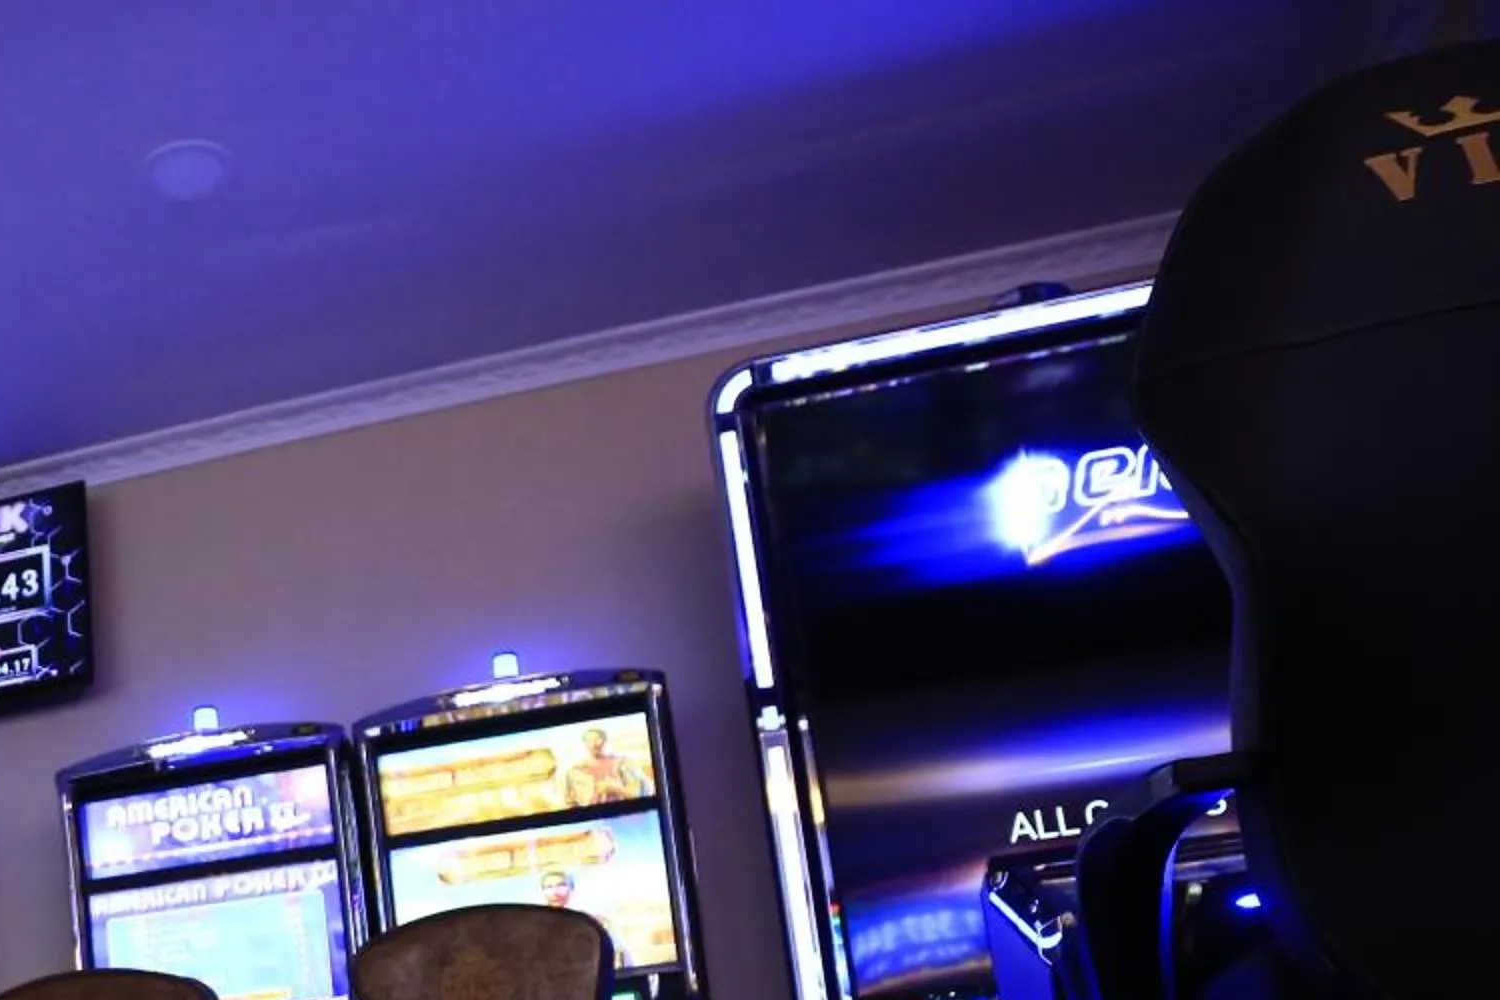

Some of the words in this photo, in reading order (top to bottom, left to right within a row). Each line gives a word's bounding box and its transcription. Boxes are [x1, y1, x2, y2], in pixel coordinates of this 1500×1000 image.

[106, 784, 254, 829] AMERICAN
[1011, 802, 1081, 844] ALL
[151, 808, 266, 846] POKER
[213, 867, 304, 900] POKER
